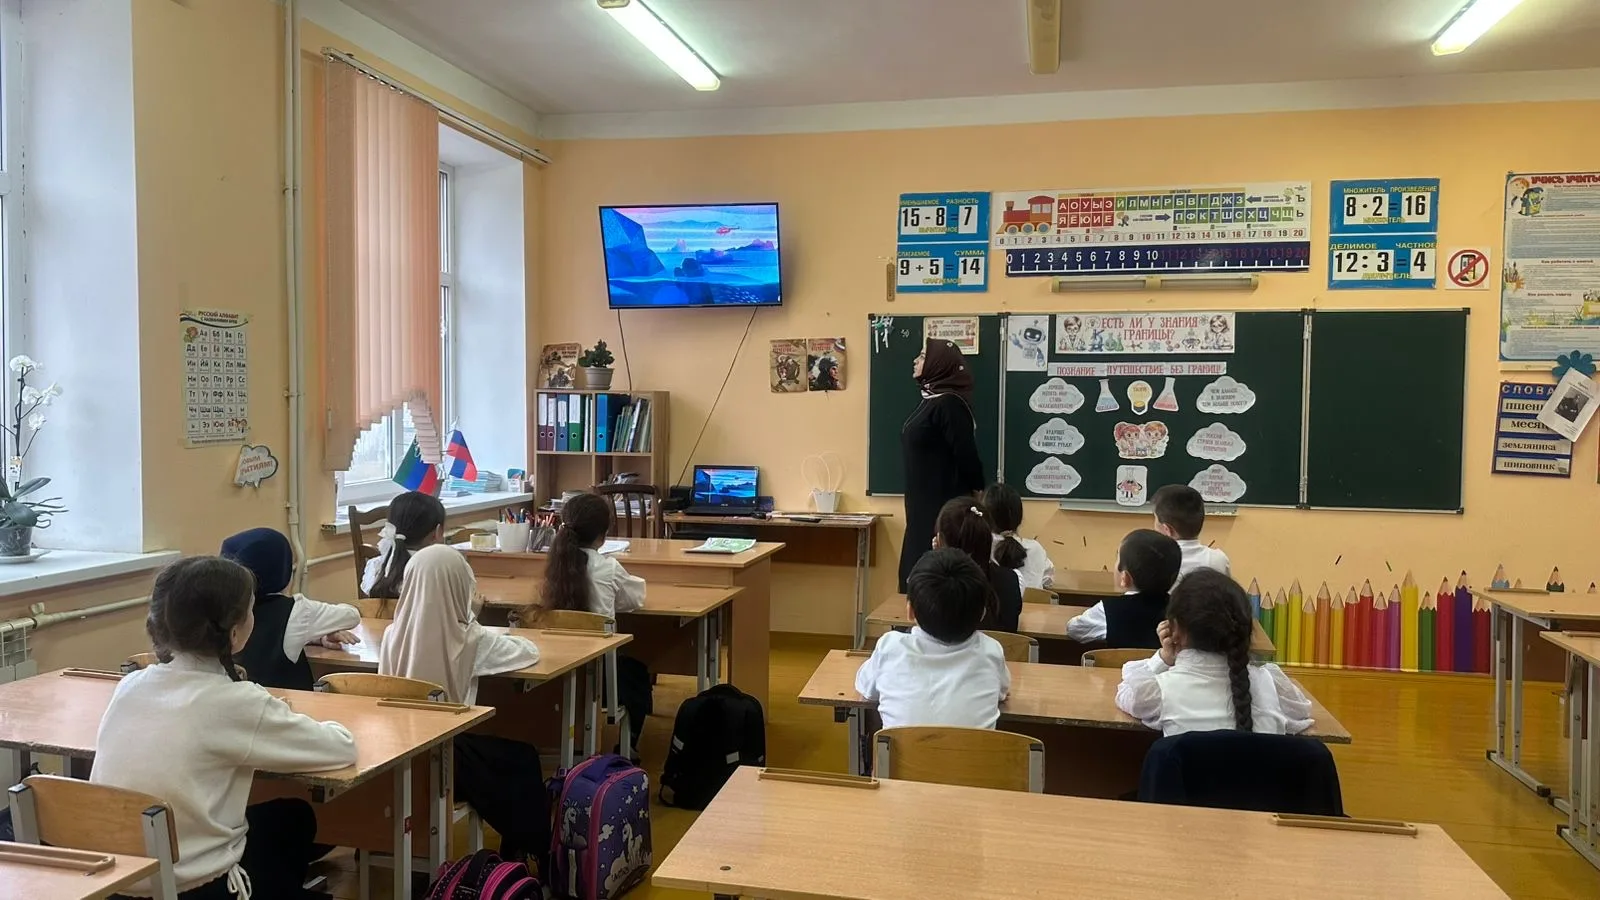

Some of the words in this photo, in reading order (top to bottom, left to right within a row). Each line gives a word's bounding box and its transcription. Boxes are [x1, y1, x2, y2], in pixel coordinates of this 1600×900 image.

[1082, 201, 1090, 209] У
[1117, 198, 1124, 207] Й
[1128, 199, 1137, 207] Л
[1139, 198, 1149, 206] М
[1152, 197, 1160, 206] Н
[1164, 196, 1173, 206] Р
[1175, 196, 1184, 206] Б
[1187, 196, 1196, 205] В
[1200, 196, 1206, 205] Г
[1211, 196, 1220, 206] Д
[1222, 196, 1233, 205] Ж
[1235, 196, 1243, 205] З
[1296, 194, 1305, 203] Ъ
[1346, 196, 1356, 216] 8
[1372, 196, 1383, 216] 2
[1405, 195, 1426, 216] 16
[902, 208, 920, 227] 15
[936, 207, 945, 226] 8
[964, 207, 972, 226] 7
[1093, 215, 1101, 223] И
[1175, 212, 1184, 221] П
[1186, 211, 1196, 221] Ф
[1199, 211, 1207, 220] К
[1210, 211, 1219, 220] Т
[1221, 211, 1232, 220] Ш
[1235, 210, 1243, 219] С
[1247, 210, 1256, 219] Х
[1259, 210, 1267, 220] Ц
[1271, 209, 1279, 218] Ч
[1282, 209, 1293, 219] Щ
[1007, 254, 1013, 264] 0
[1021, 254, 1025, 263] 1
[1034, 254, 1041, 263] 2
[1048, 253, 1054, 262] 3
[1062, 252, 1068, 262] 4
[1076, 252, 1082, 262] 5
[1090, 252, 1096, 261] 6
[1104, 251, 1111, 261] 7
[1119, 250, 1125, 260] 8
[1134, 250, 1140, 260] 9
[1147, 250, 1158, 260] 10
[1335, 252, 1358, 272] 12
[1377, 252, 1389, 272] 3
[1414, 252, 1426, 272] 4
[900, 260, 910, 275] 9
[929, 259, 940, 275] 5
[961, 258, 980, 274] 14
[1101, 317, 1124, 328] ЕСТЬ
[1129, 318, 1142, 328] ЛИ
[1149, 317, 1155, 328] У
[1160, 317, 1199, 328] ЗНАНИЯ
[1124, 329, 1176, 341] ГРАНИЦЫ?
[1056, 366, 1096, 375] ПОЗНАНИЕ
[1107, 364, 1164, 374] ПУТЕШЕСТВИЕ
[1170, 365, 1184, 374] БЕЗ
[1502, 442, 1556, 451] земляника
[1504, 461, 1555, 470] шиповник
